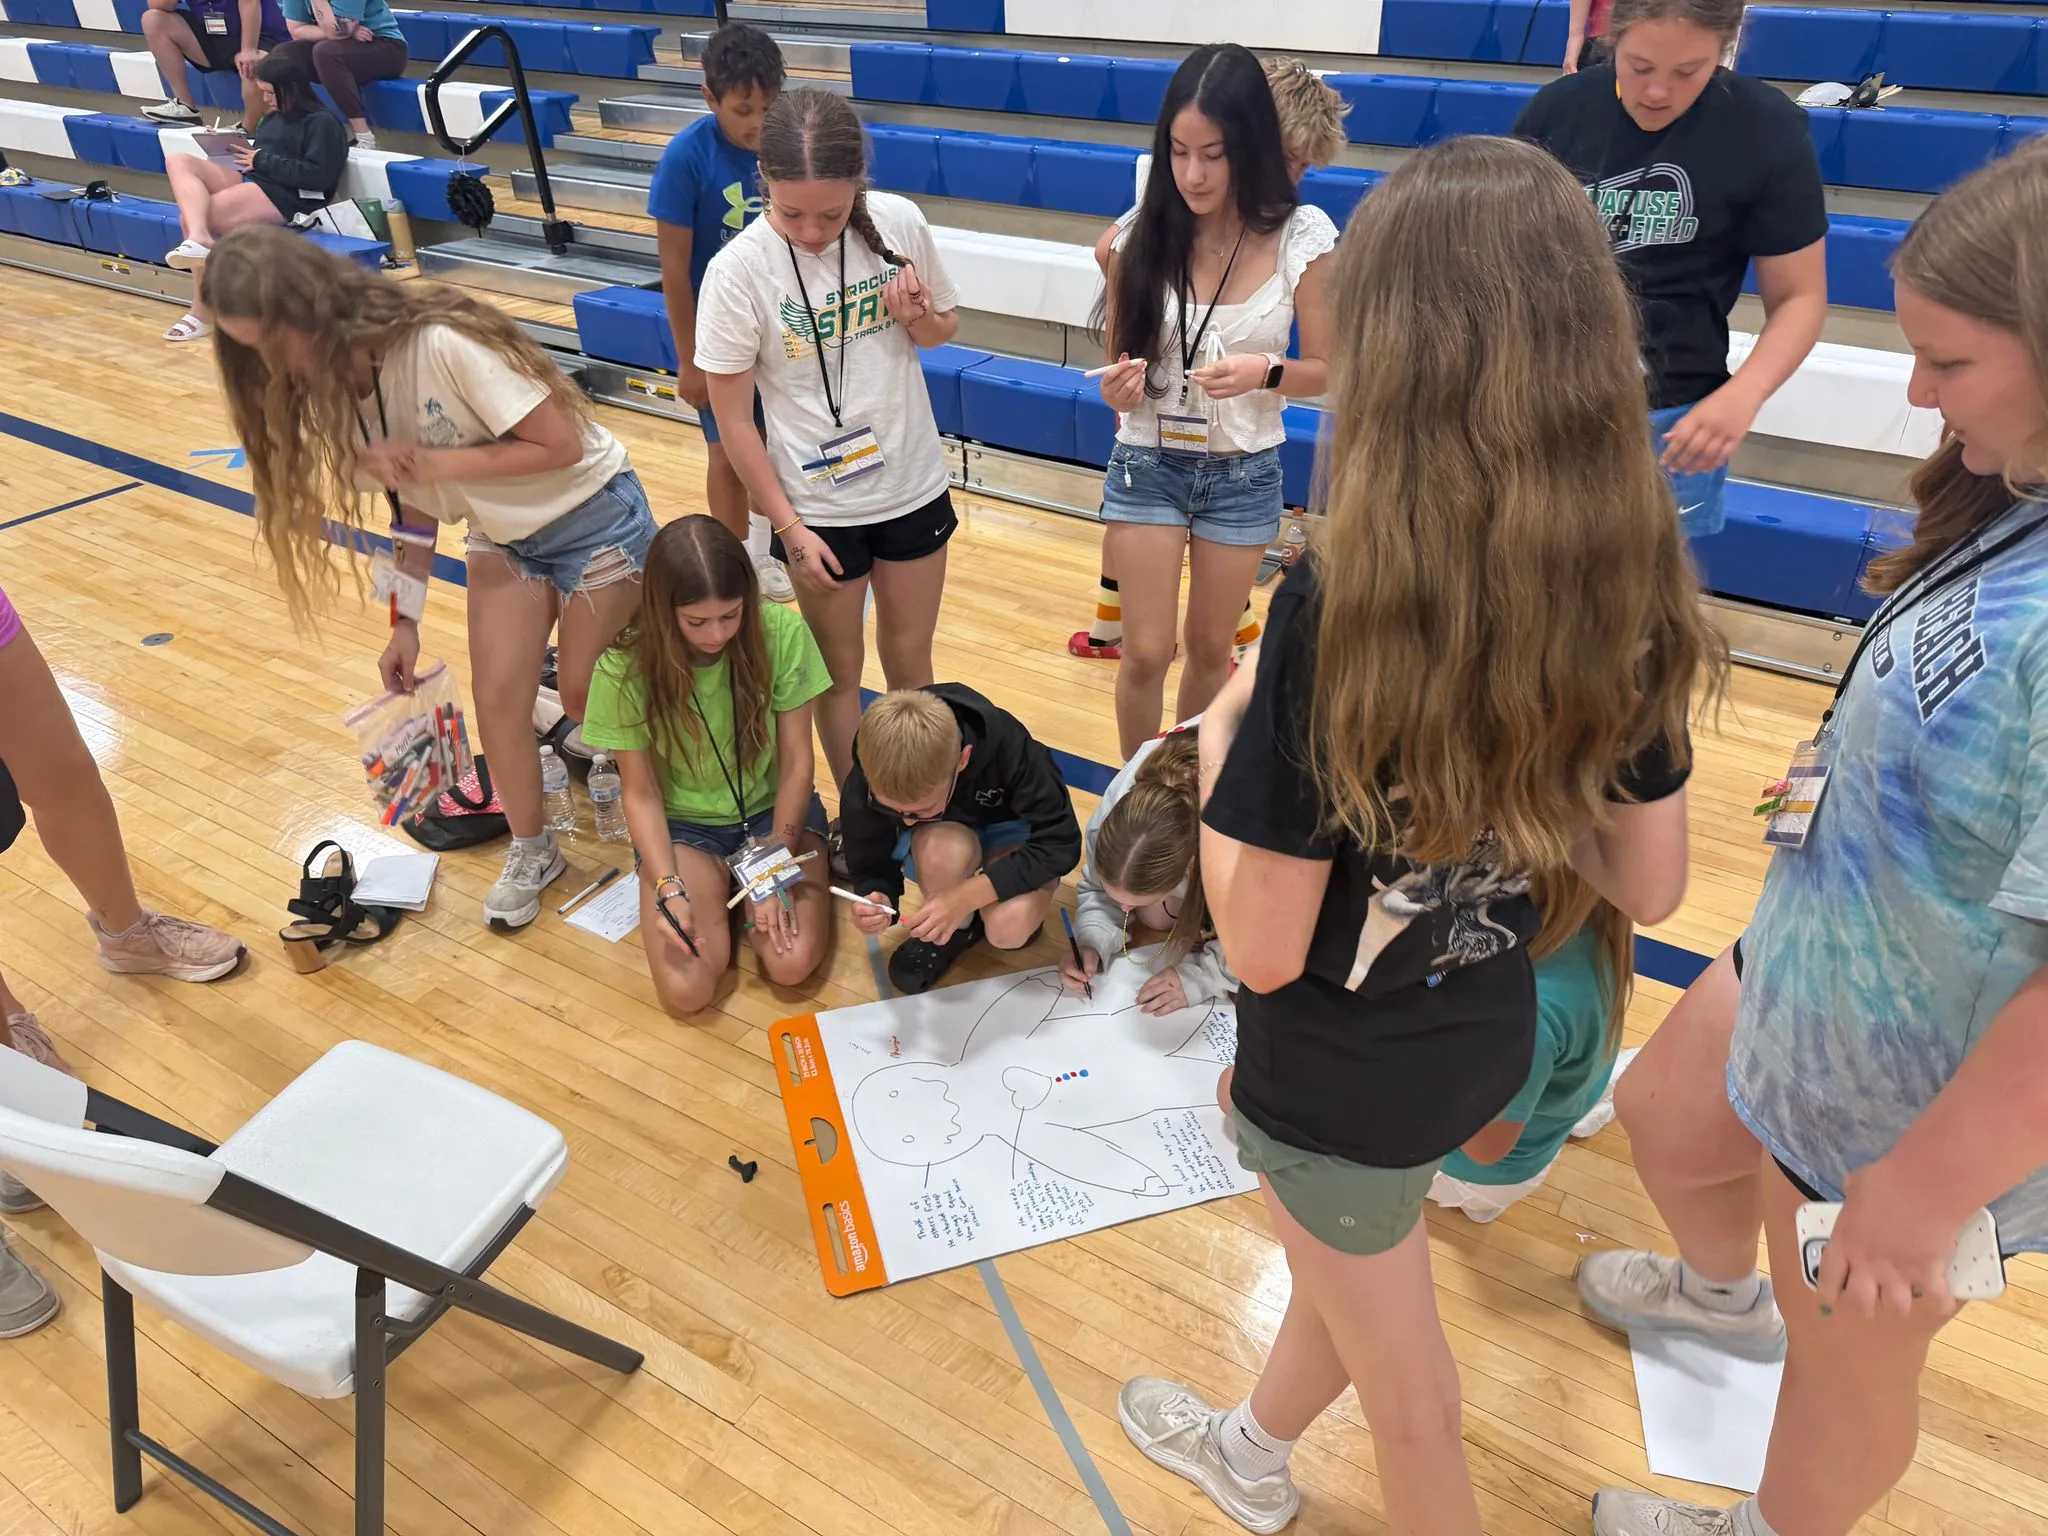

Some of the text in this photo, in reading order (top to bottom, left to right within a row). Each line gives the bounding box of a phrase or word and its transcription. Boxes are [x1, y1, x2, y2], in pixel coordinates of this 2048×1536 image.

[1912, 577, 1987, 726] BEACH
[909, 1201, 926, 1239] Think of
[938, 1212, 951, 1234] should
[950, 1214, 963, 1237] things
[839, 1200, 865, 1271] amazon basics
[947, 1238, 955, 1248] He
